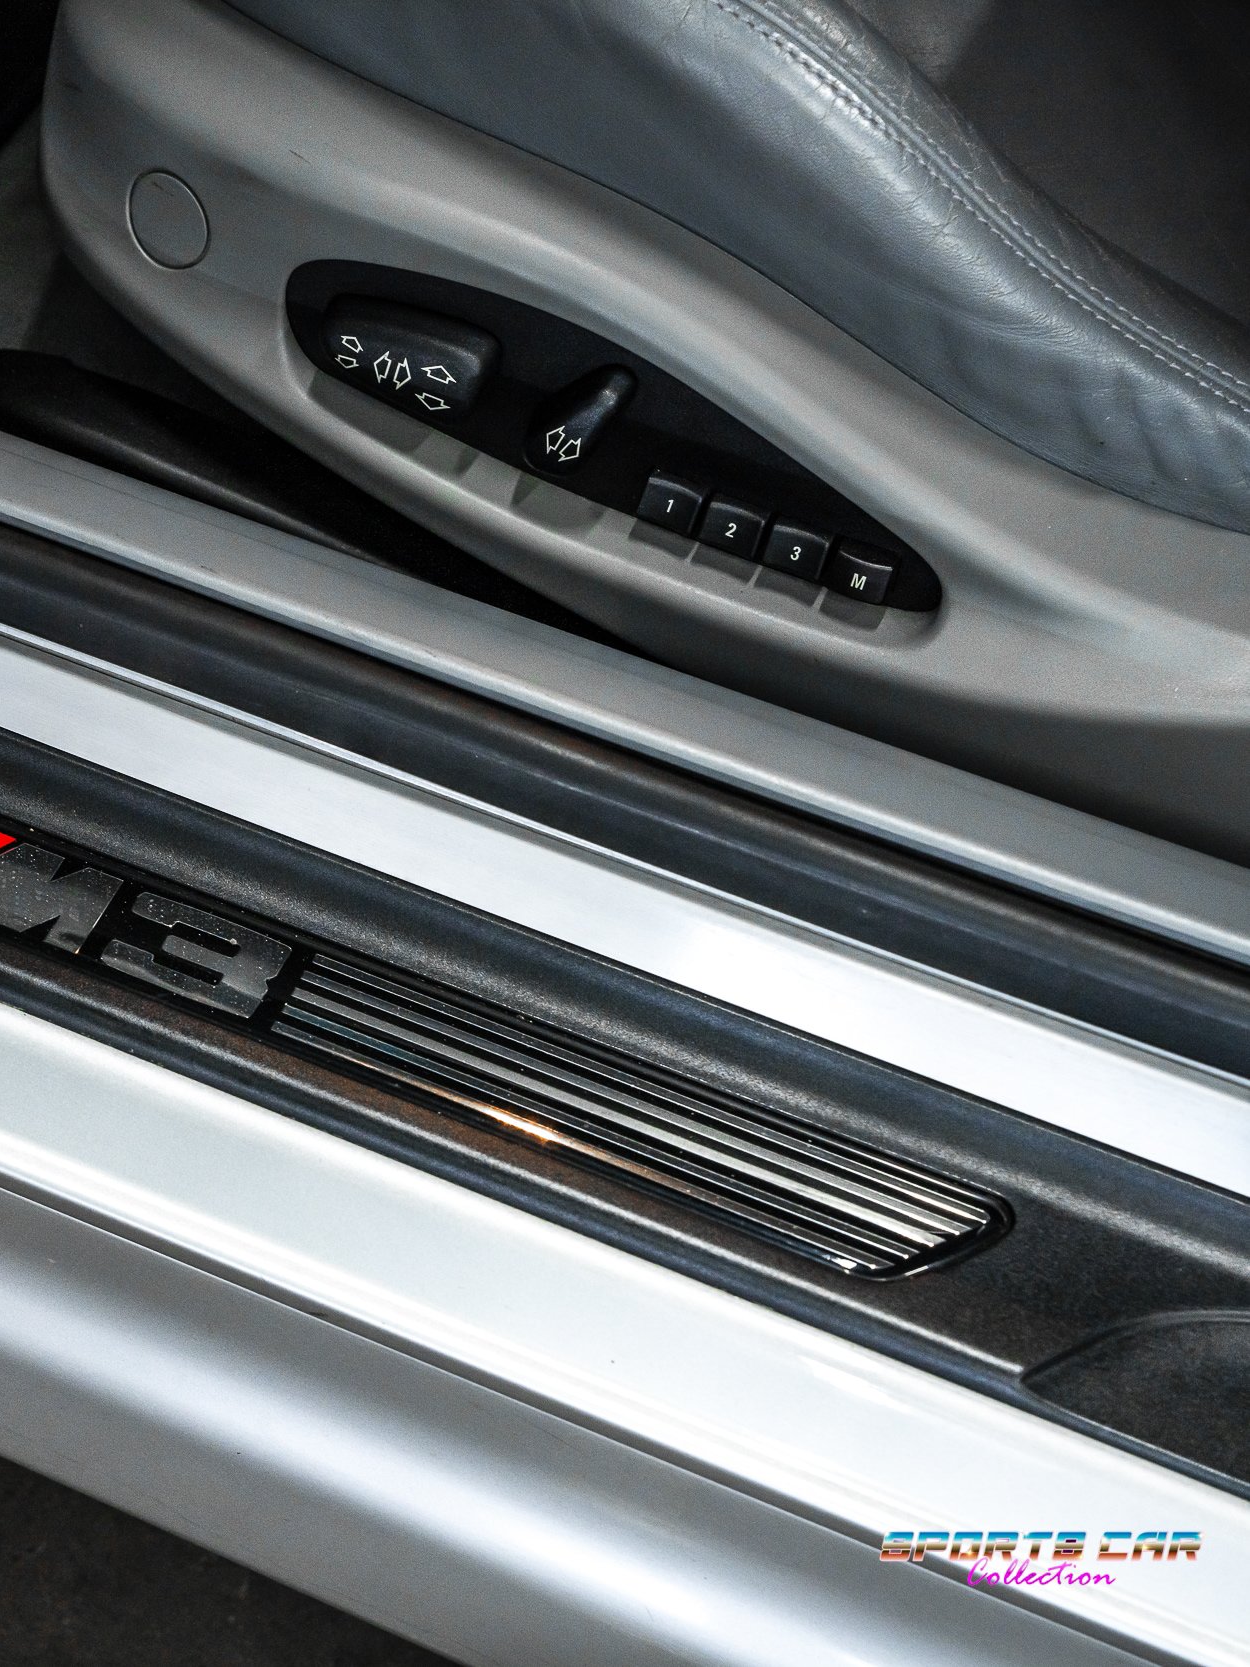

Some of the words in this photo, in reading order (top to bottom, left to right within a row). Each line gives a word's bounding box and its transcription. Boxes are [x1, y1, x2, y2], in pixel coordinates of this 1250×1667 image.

[666, 499, 675, 513] 1
[724, 522, 737, 538] 2
[790, 546, 802, 561] 3
[850, 573, 867, 591] M
